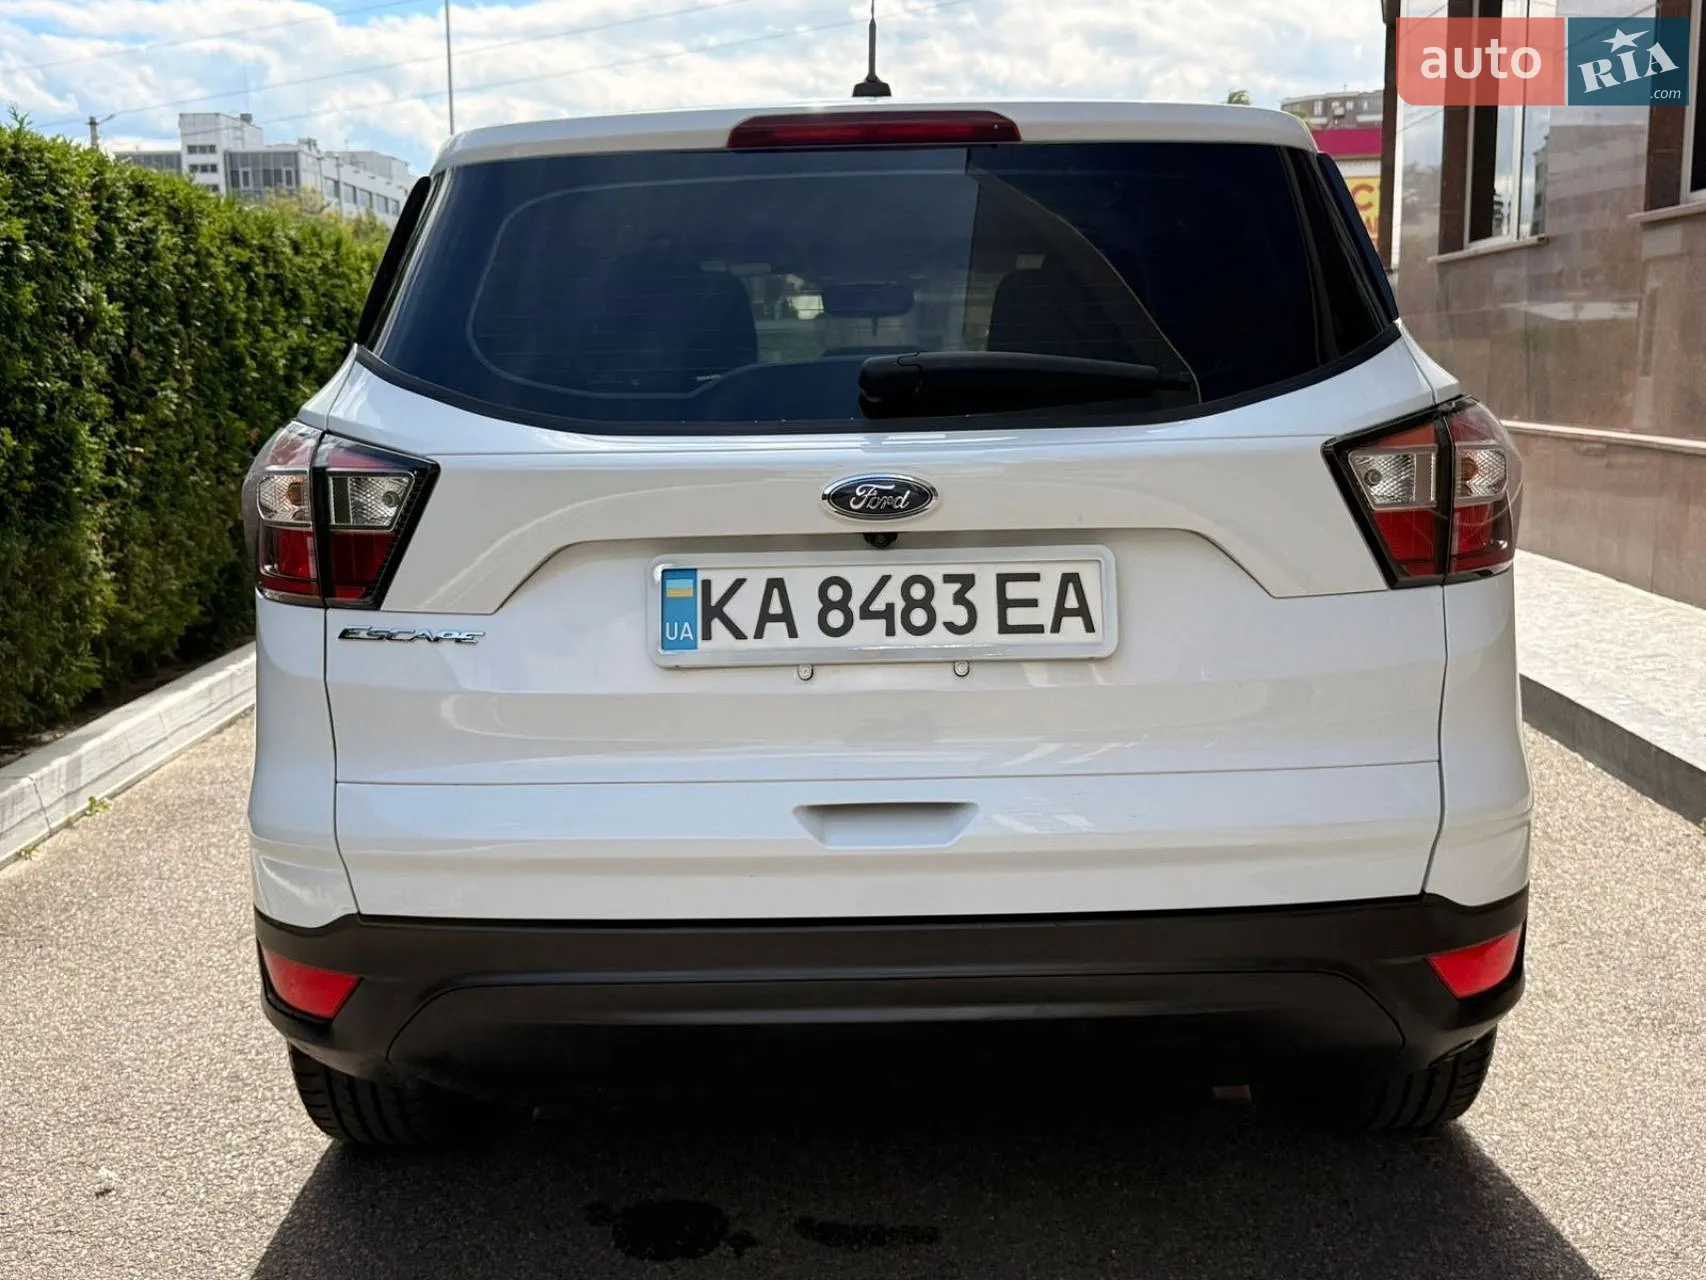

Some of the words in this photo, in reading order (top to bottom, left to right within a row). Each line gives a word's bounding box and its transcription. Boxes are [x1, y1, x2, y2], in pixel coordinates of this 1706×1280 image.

[849, 483, 911, 510] Ford
[701, 577, 799, 641] KA
[817, 574, 978, 638] 8483
[996, 572, 1096, 635] EA
[338, 624, 486, 645] ESCAPE
[665, 622, 694, 641] UA
